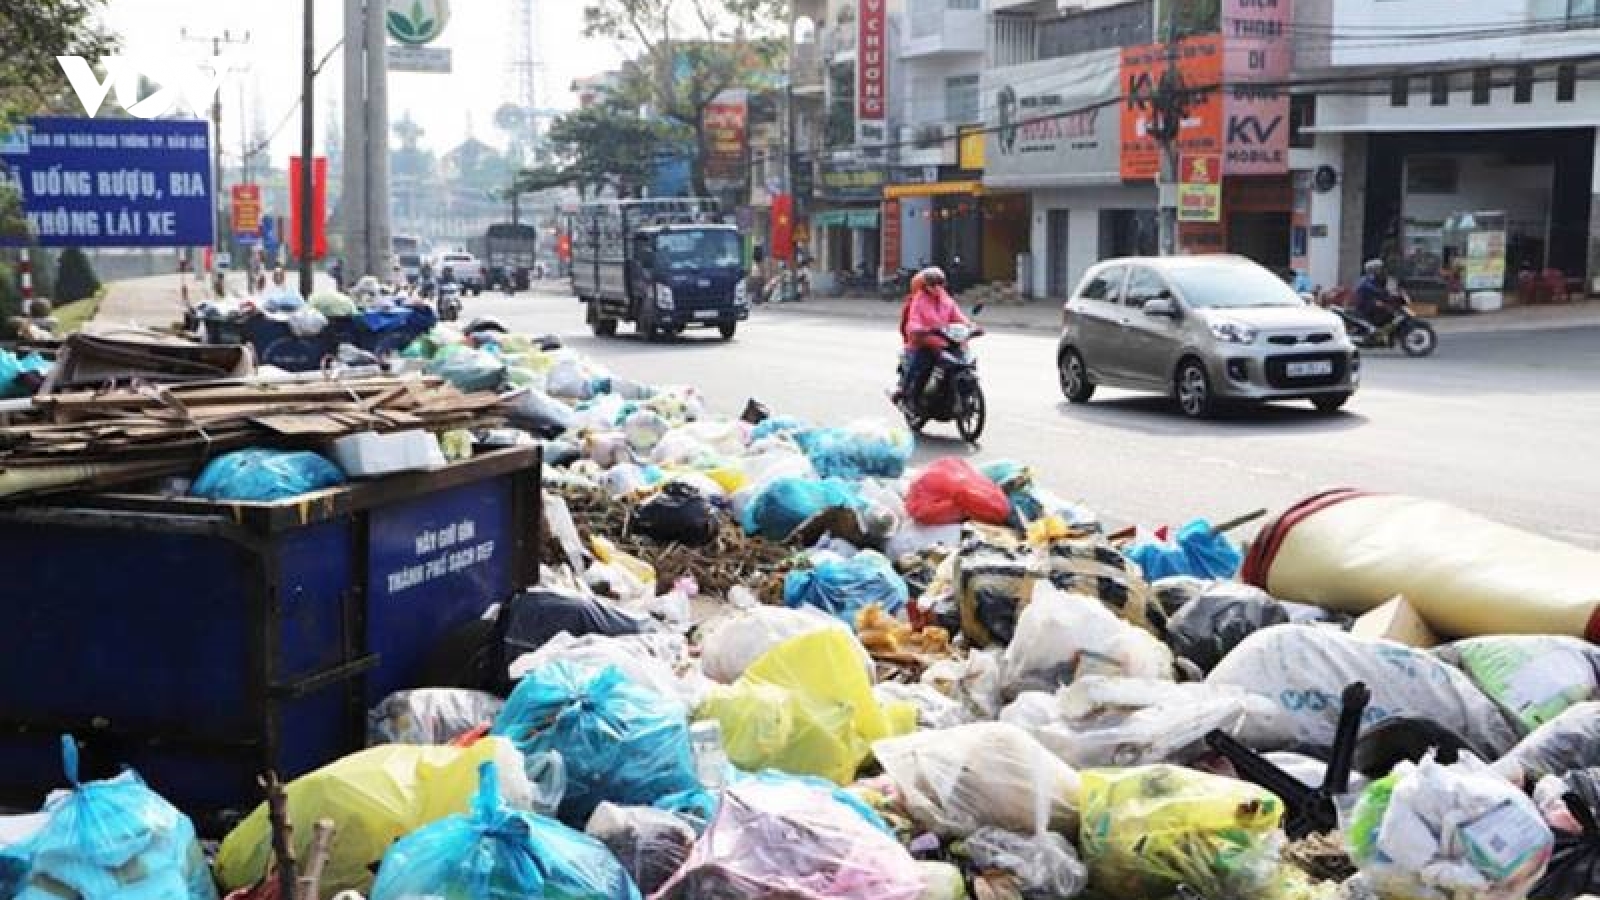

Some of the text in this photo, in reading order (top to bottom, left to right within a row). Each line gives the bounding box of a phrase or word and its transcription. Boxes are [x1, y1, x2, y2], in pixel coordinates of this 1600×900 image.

[1228, 113, 1283, 144] KV
[1227, 150, 1282, 164] MOBILE
[32, 163, 91, 196] UỐNG
[98, 168, 163, 201] RƯỢU,
[169, 171, 206, 196] BIA
[26, 206, 176, 236] KHÔNG LÁI XE
